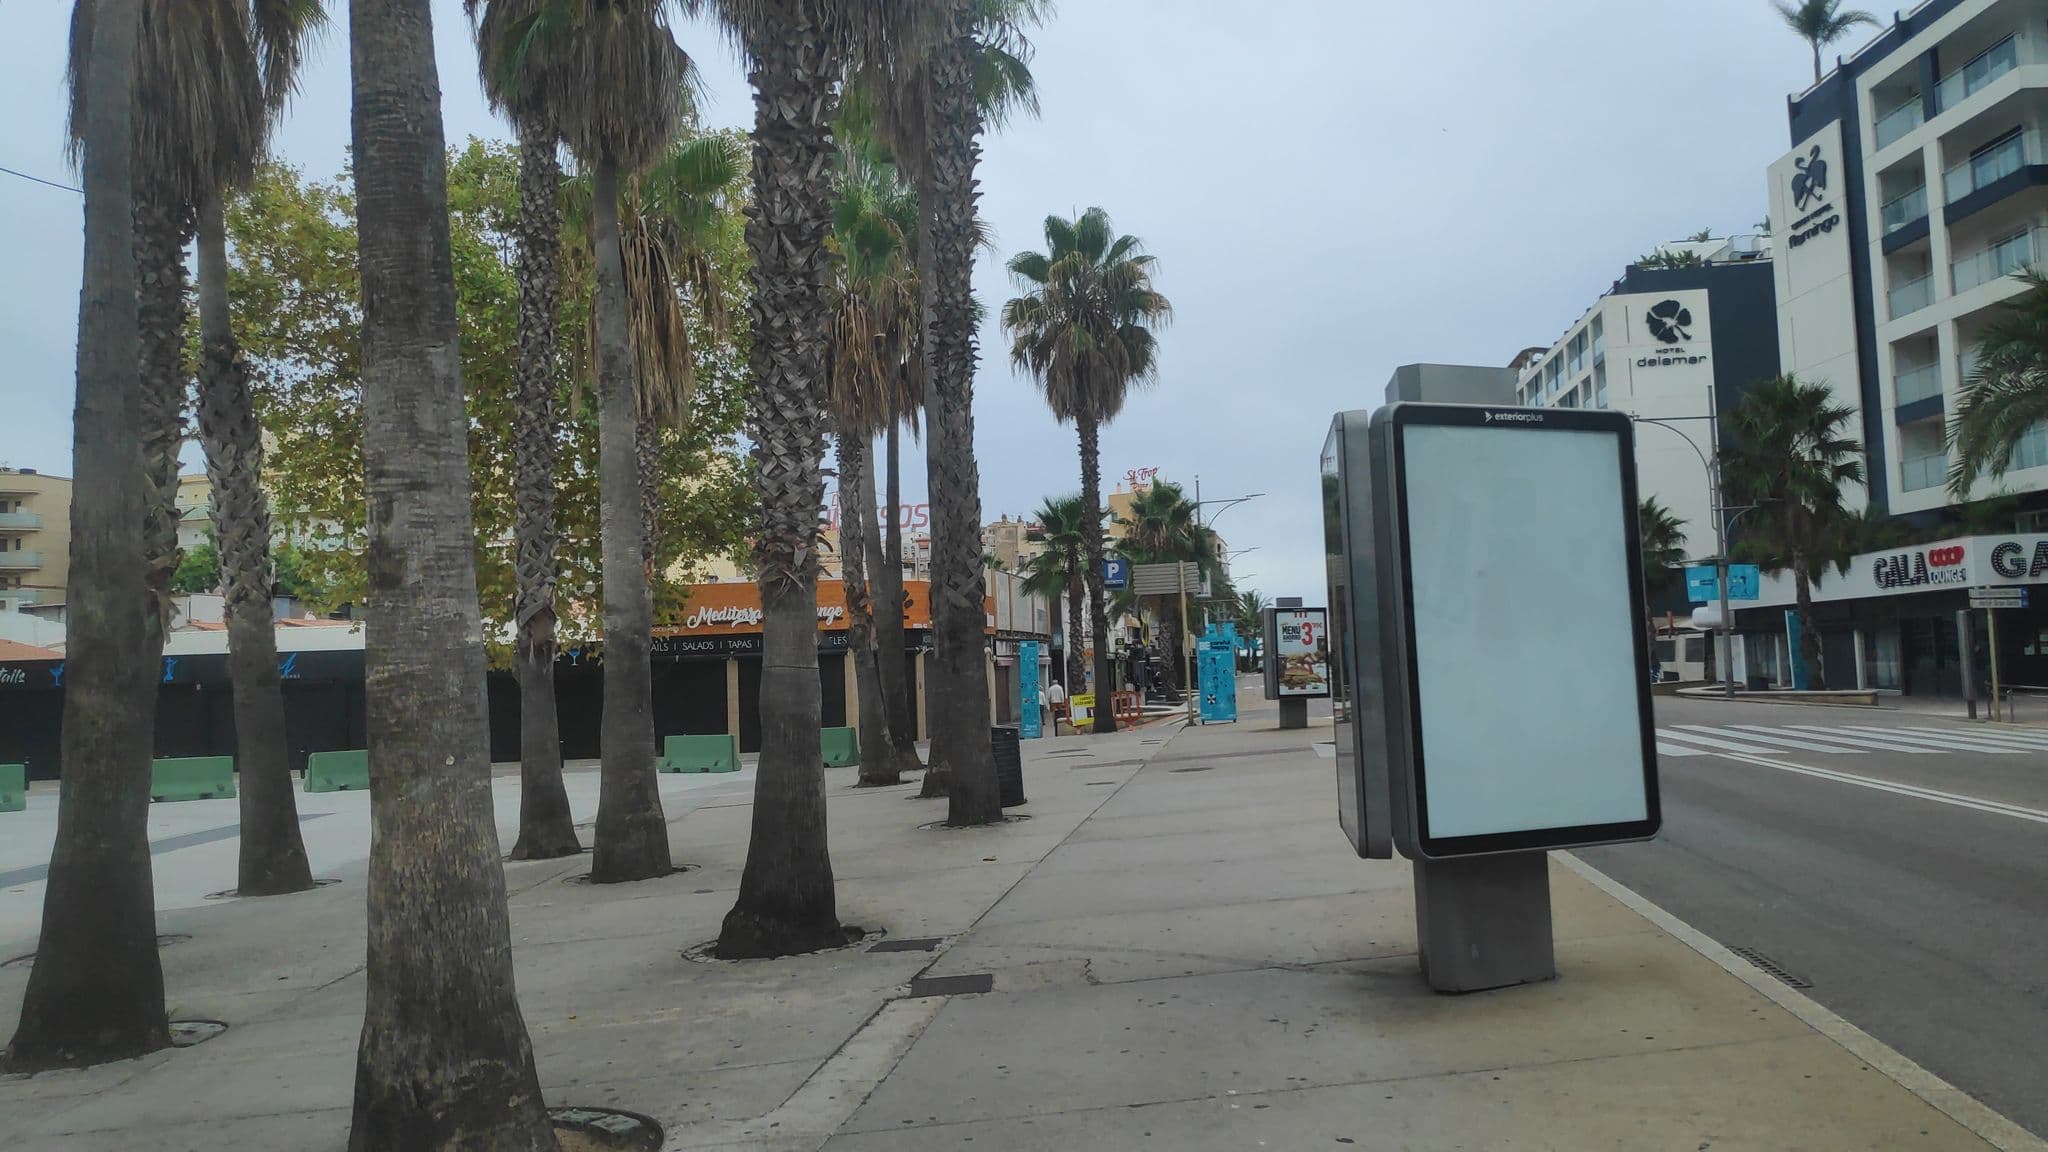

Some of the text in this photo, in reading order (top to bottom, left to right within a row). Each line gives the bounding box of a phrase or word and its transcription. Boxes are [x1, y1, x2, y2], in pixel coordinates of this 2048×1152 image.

[1637, 356, 1707, 367] delamar
[1495, 412, 1544, 423] exteriorplus
[1107, 563, 1119, 578] P
[1873, 552, 1930, 588] GALA
[687, 605, 763, 629] Mediterra
[1302, 622, 1313, 645] 3
[650, 641, 669, 652] AILS
[682, 641, 714, 650] SALADS
[727, 640, 752, 649] TAPAS
[0, 668, 26, 684] tails
